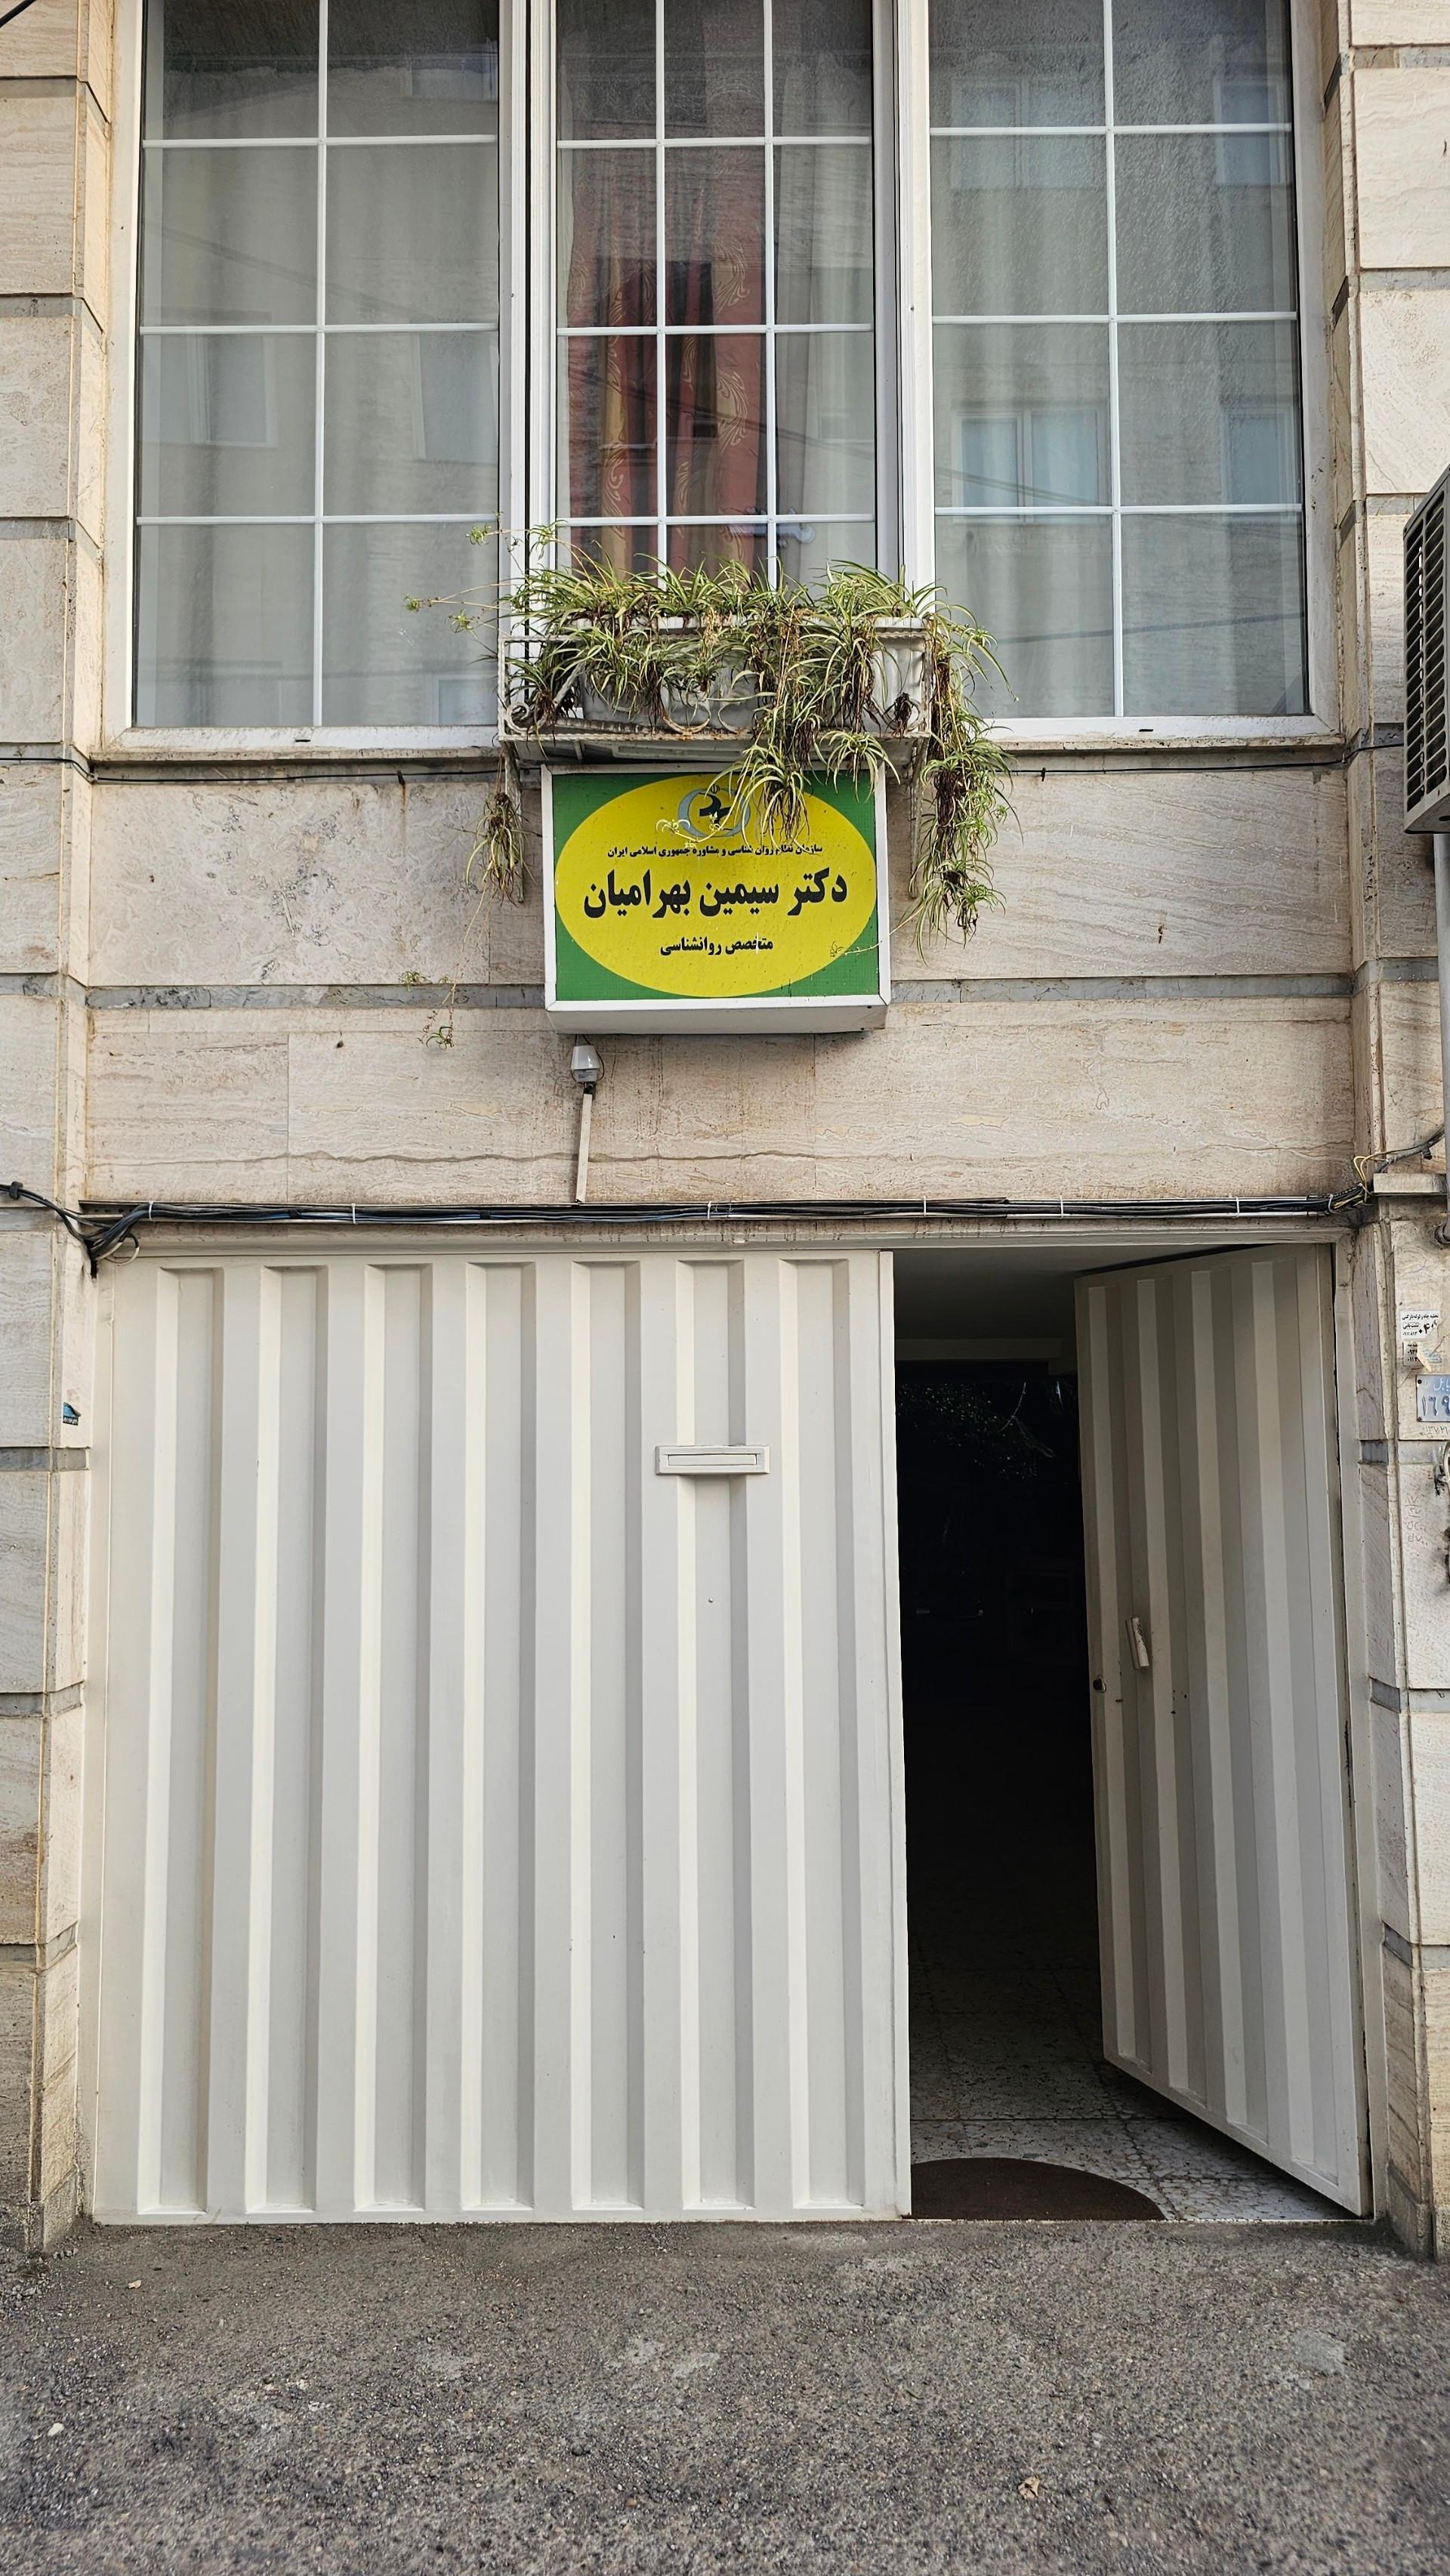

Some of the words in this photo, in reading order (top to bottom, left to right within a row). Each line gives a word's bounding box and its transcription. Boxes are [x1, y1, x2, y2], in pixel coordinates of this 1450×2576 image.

[607, 846, 628, 858] ایران
[629, 846, 657, 857] اسلامی
[658, 847, 690, 857] جمهوری
[692, 845, 720, 857] مشاوره
[720, 848, 727, 857] و
[754, 845, 774, 855] روان
[776, 844, 794, 855] نظام
[795, 843, 822, 855] سازمان
[584, 869, 691, 919] بهرامیان
[787, 866, 847, 916] دکتر
[699, 882, 779, 917] سیمین
[660, 937, 722, 956] روانشناسی
[725, 936, 773, 955] متخصص
